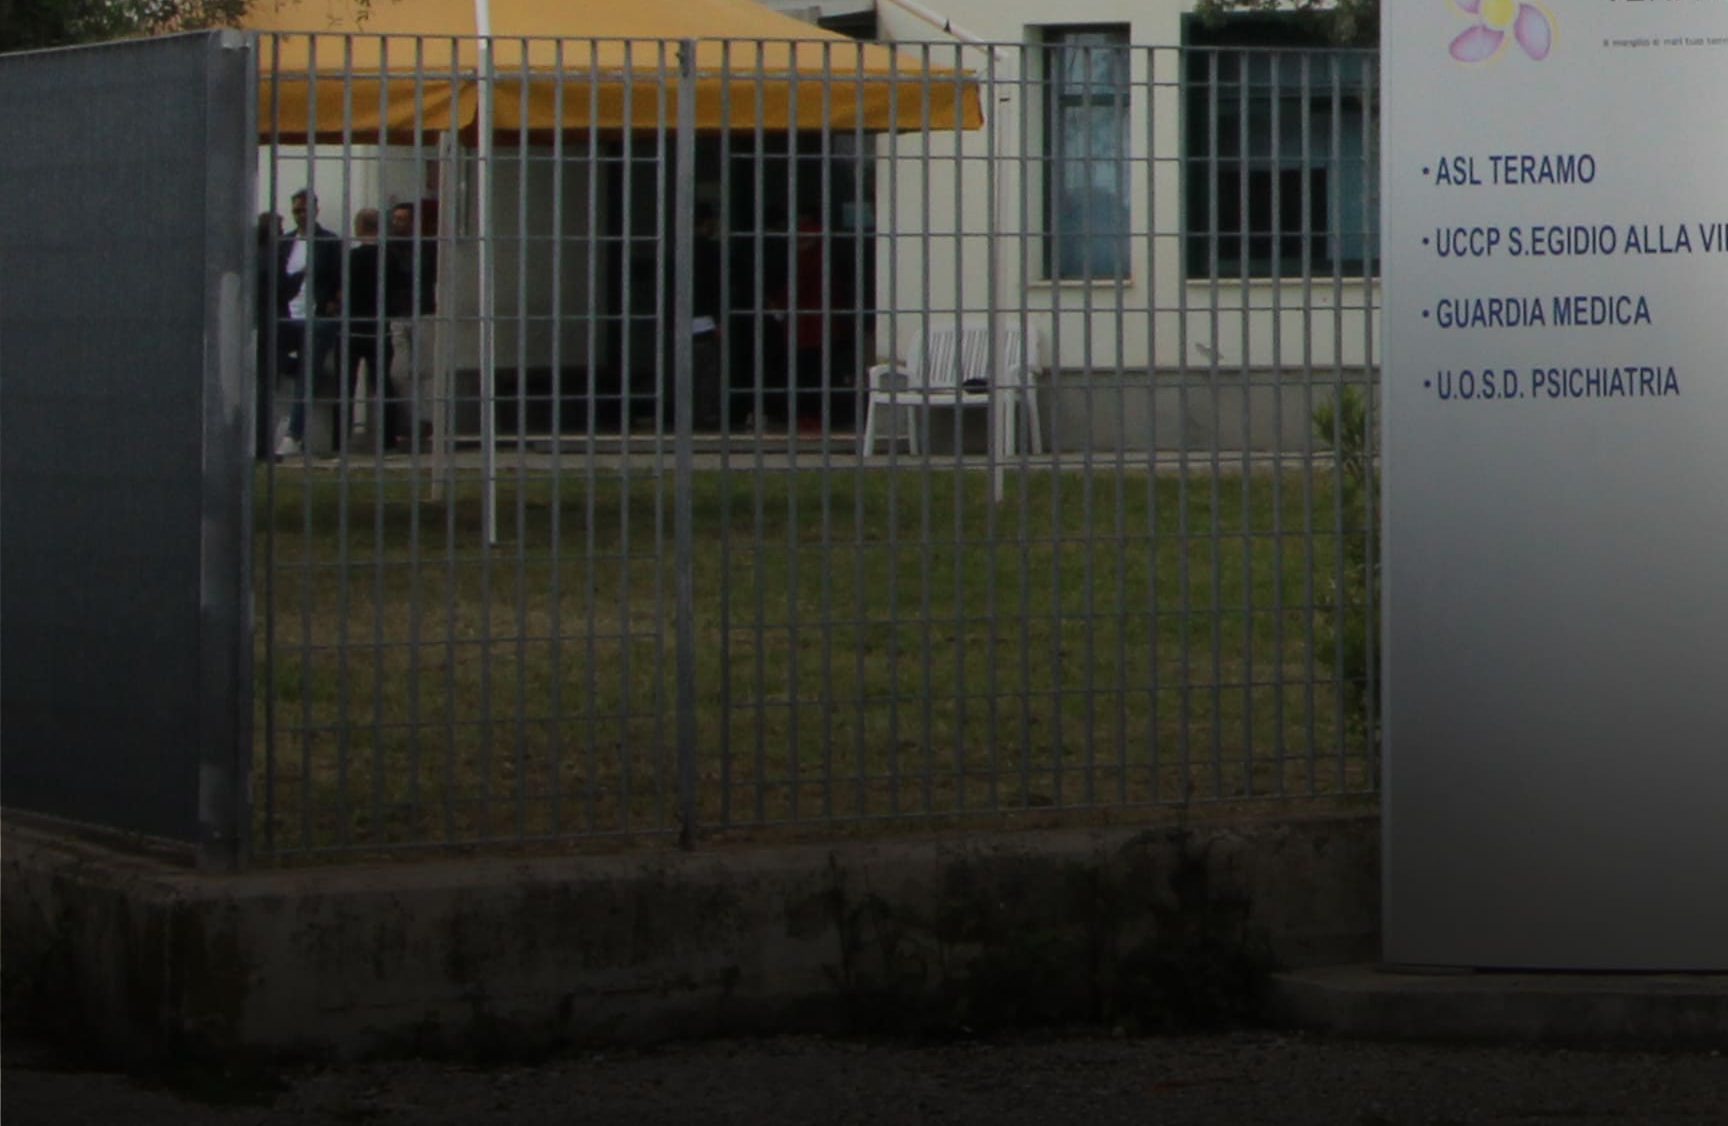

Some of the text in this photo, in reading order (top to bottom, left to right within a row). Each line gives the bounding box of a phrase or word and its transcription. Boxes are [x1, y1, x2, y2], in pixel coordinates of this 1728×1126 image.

[1435, 153, 1597, 186] ASL TERAMO
[1436, 226, 1501, 258] UCCP
[1507, 224, 1618, 257] S.EGIDIO
[1623, 223, 1693, 255] ALLA
[1436, 294, 1652, 329] GUARDIA MEDICA
[1437, 366, 1681, 401] U.O.S.D. PSICHIATRIA
